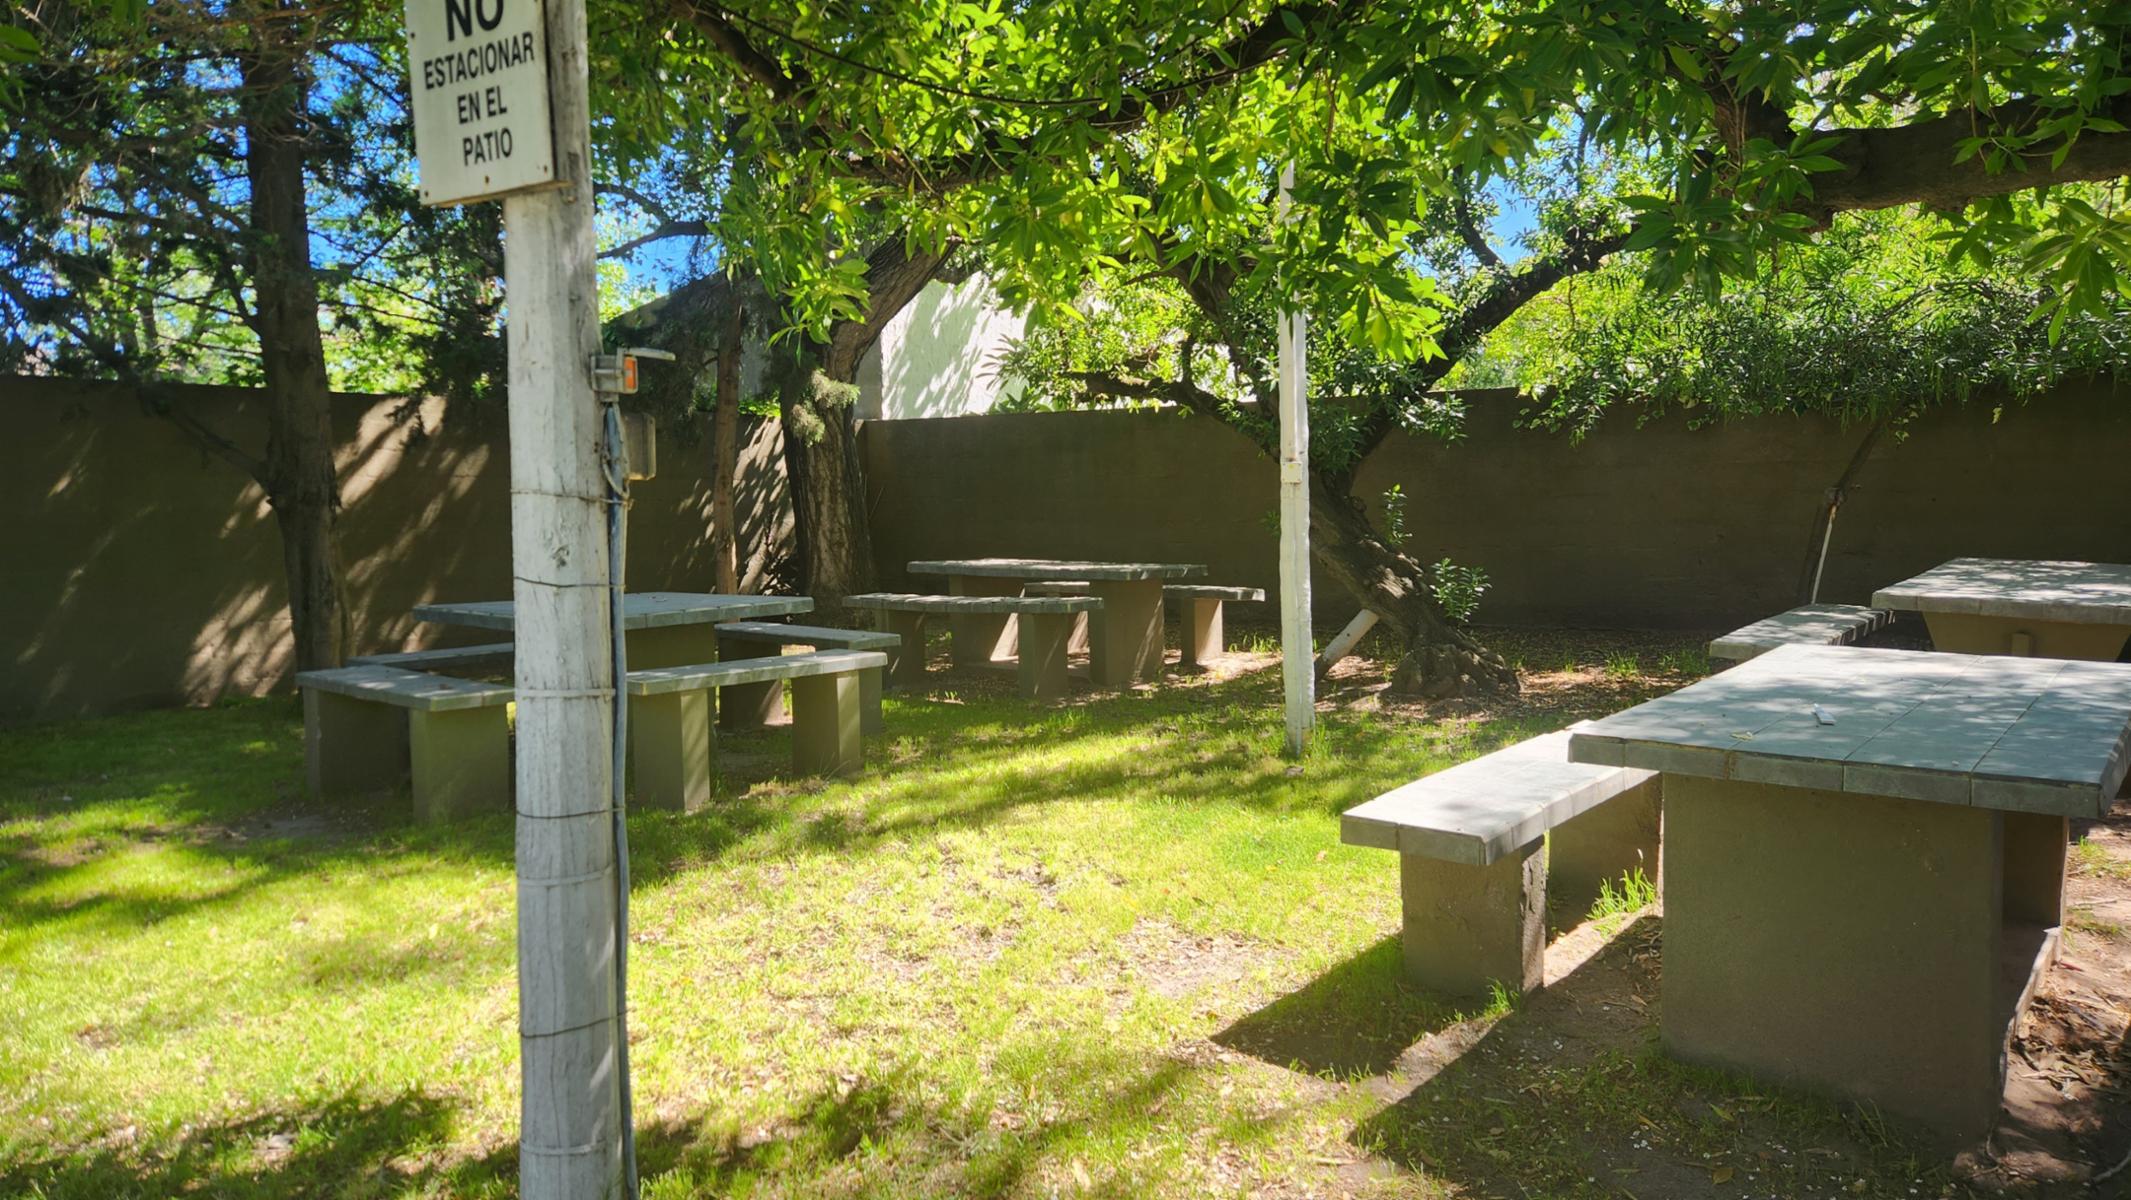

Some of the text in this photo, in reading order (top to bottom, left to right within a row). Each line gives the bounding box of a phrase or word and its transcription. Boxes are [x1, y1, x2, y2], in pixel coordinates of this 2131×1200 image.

[445, 0, 504, 42] NO
[424, 32, 534, 90] ESTACIONAR
[457, 86, 508, 124] EN EL
[463, 128, 513, 167] PATIO
